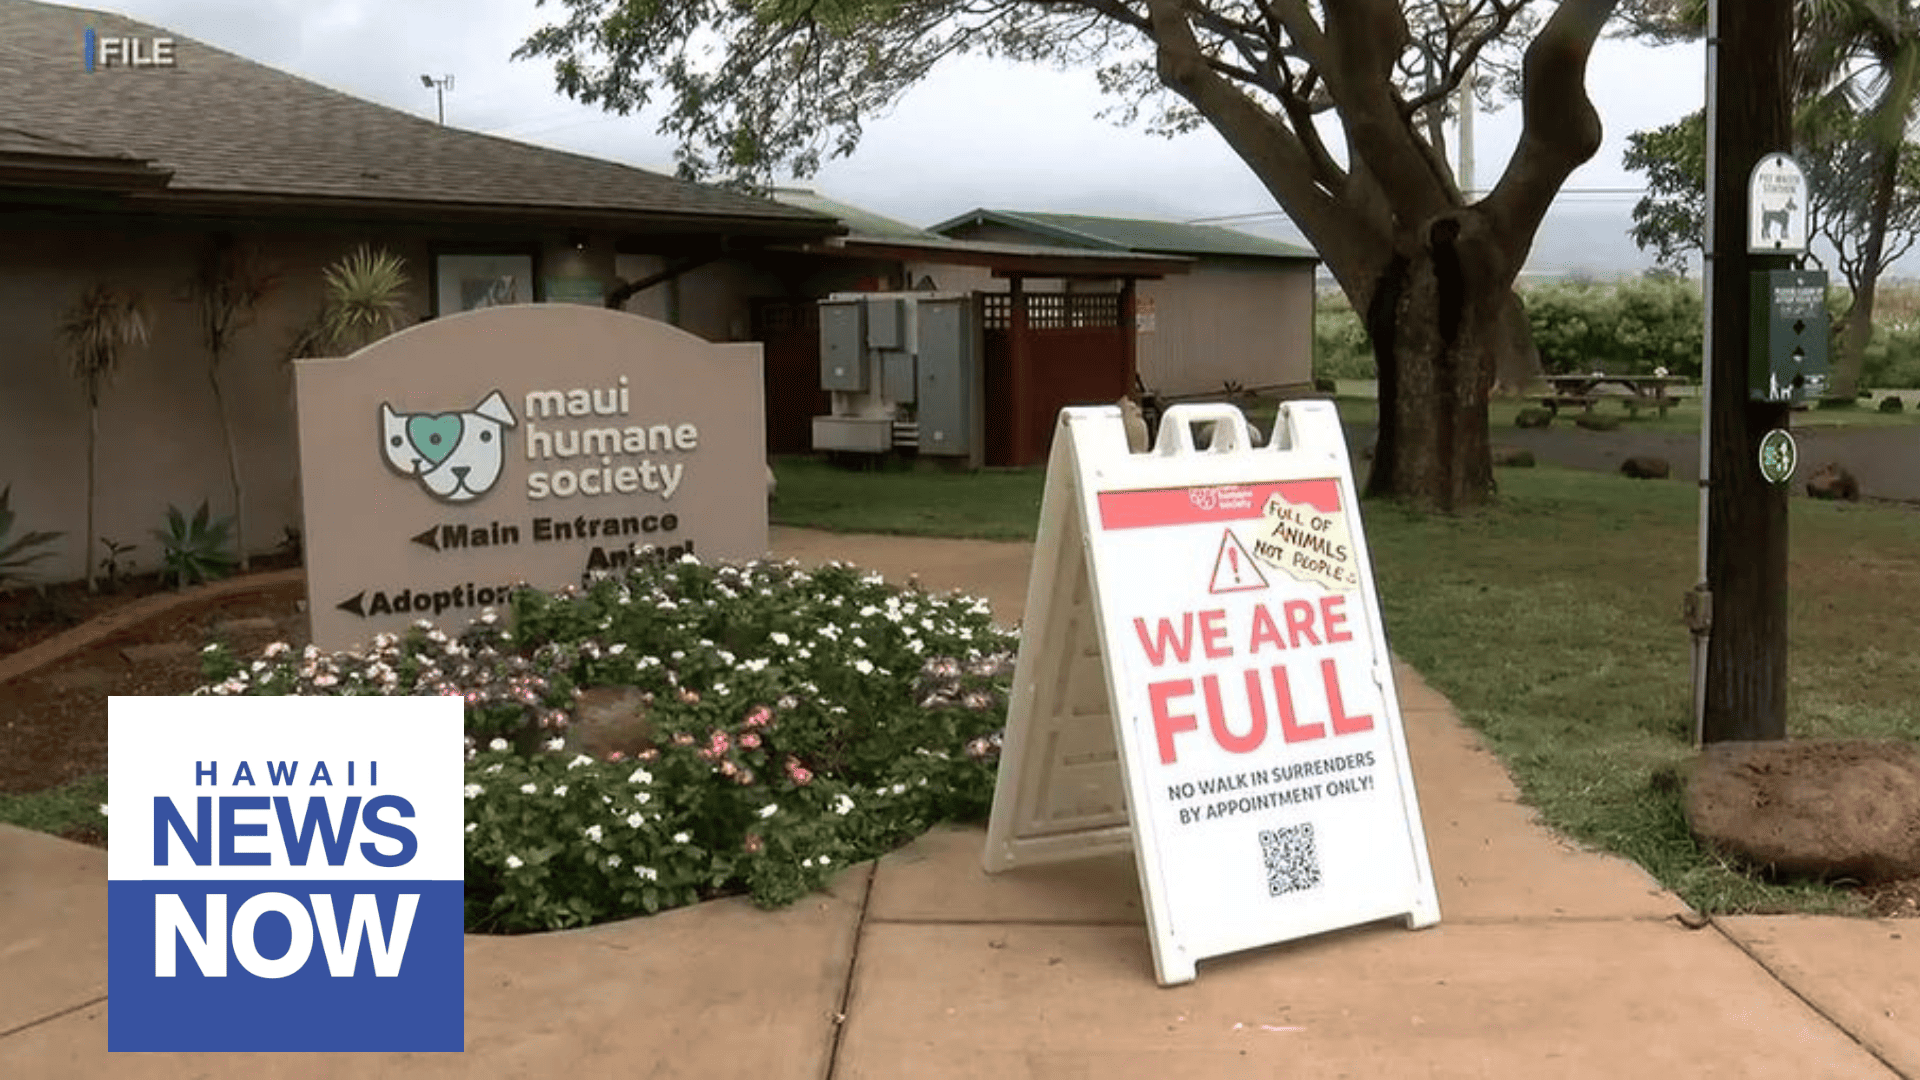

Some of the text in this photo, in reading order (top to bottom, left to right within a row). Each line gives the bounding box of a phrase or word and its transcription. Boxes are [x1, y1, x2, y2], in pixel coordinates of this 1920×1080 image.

[525, 375, 630, 418] maui
[526, 421, 699, 460] humane
[527, 458, 684, 499] society
[442, 510, 679, 551] Main Entrance
[1269, 500, 1333, 532] FULL OF
[586, 540, 695, 571] Anial
[1254, 538, 1345, 582] NOT PEOPLE
[1271, 521, 1347, 563] ANIMALS
[1133, 595, 1353, 667] WE ARE
[1148, 657, 1375, 766] FULL
[1168, 751, 1377, 801] NO WALK IN SURRENDERS
[1179, 775, 1375, 825] BY APPOINTMENT ONLY!
